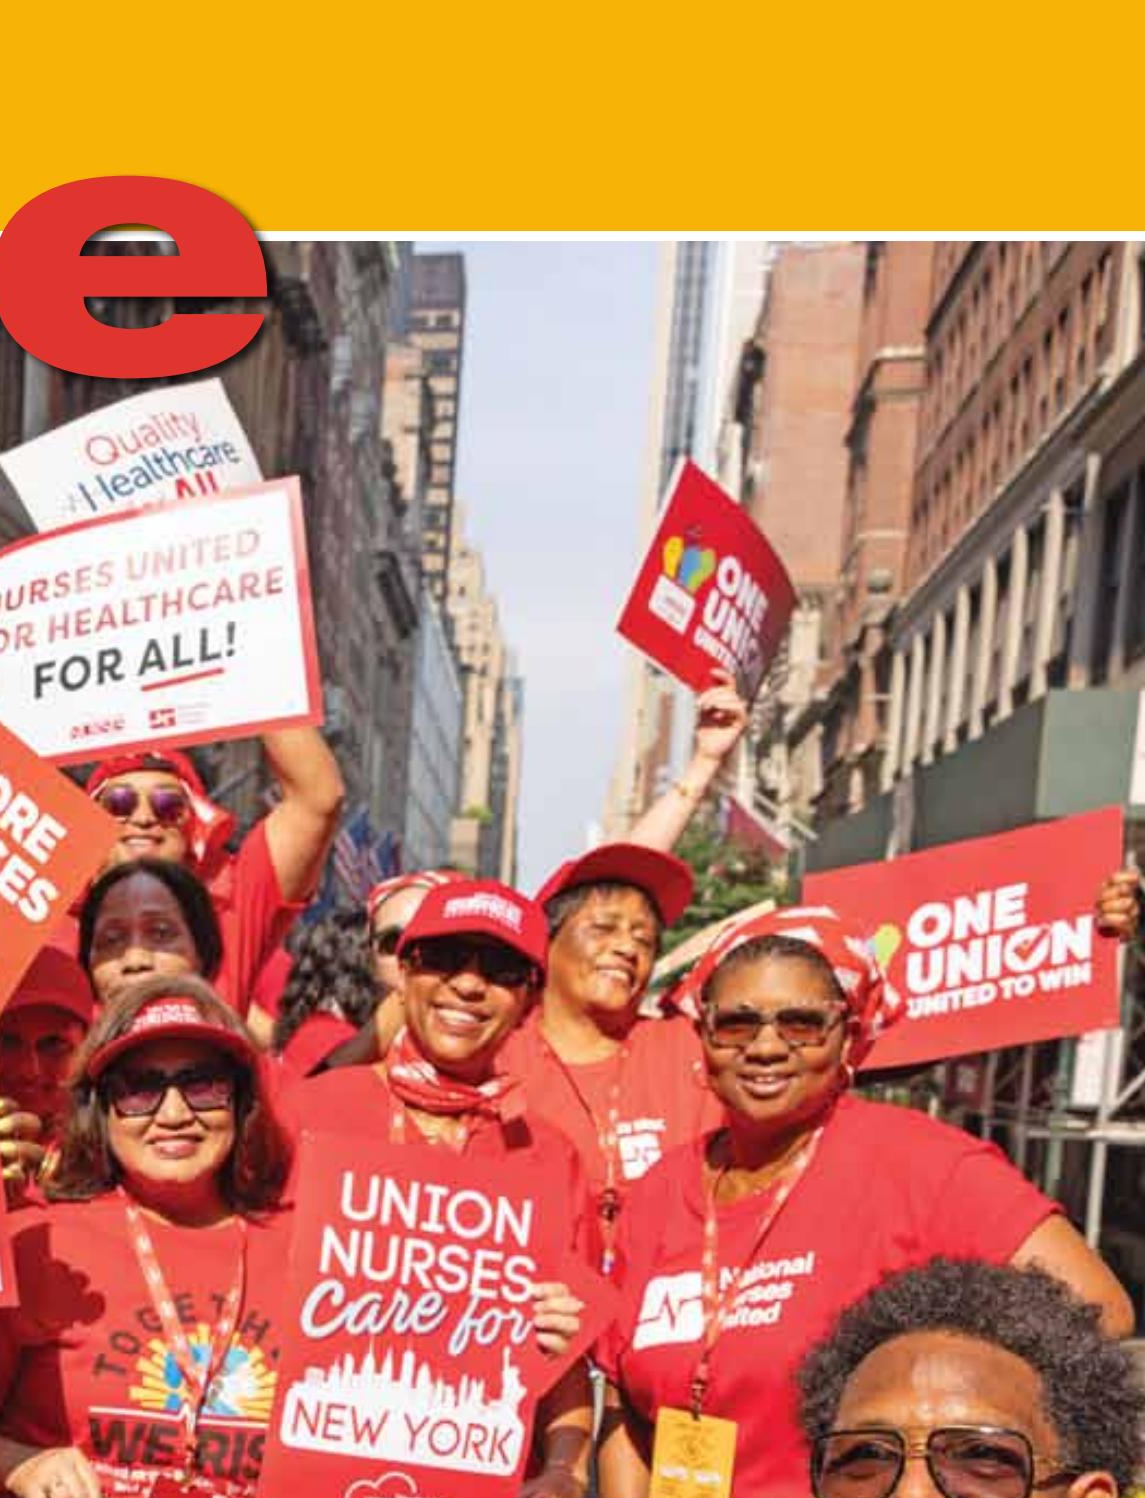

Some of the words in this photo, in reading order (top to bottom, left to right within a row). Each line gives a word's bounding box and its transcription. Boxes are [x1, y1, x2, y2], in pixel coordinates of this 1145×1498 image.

[77, 440, 241, 512] Healthcare
[85, 411, 202, 466] Quality
[126, 528, 261, 580] UNITED
[47, 566, 284, 645] HEALTHCARE
[717, 555, 768, 633] ONE
[33, 647, 125, 700] FOR
[137, 621, 237, 677] ALL!
[906, 882, 1028, 948] ONE
[906, 915, 1094, 995] UNION
[906, 981, 998, 1020] UNITED
[1001, 973, 1036, 1001] TO
[1037, 960, 1092, 993] WIN
[339, 1170, 534, 1249] UNION
[317, 1225, 538, 1304] NURSES
[91, 1292, 280, 1377] TOGETH
[299, 1280, 450, 1340] Care
[447, 1300, 534, 1357] for
[88, 1416, 179, 1465] WE
[196, 1428, 266, 1480] RIS
[289, 1398, 390, 1444] NEW
[405, 1414, 516, 1466] YORK
